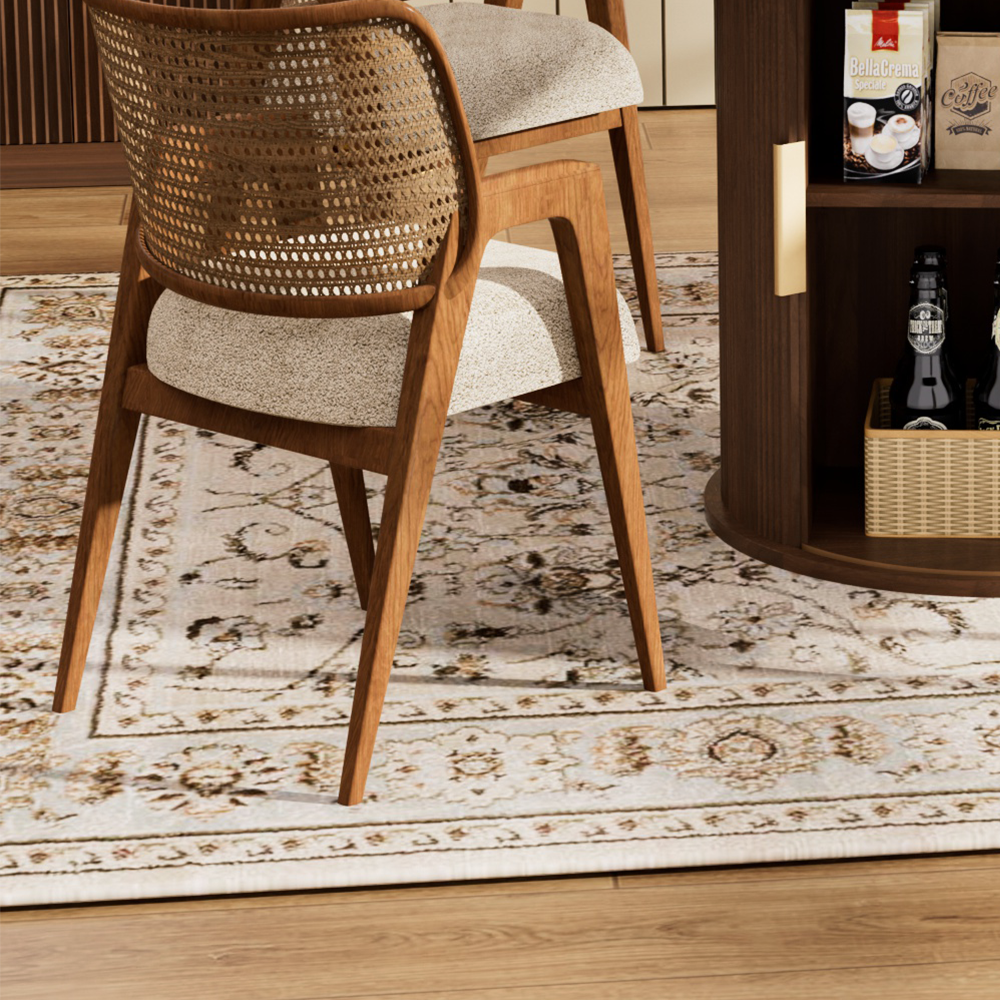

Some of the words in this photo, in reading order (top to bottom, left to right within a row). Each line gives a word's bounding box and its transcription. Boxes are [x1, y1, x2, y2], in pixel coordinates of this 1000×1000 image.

[849, 57, 920, 79] BellaCrema
[854, 79, 887, 92] Speciale
[941, 81, 998, 109] Coffee
